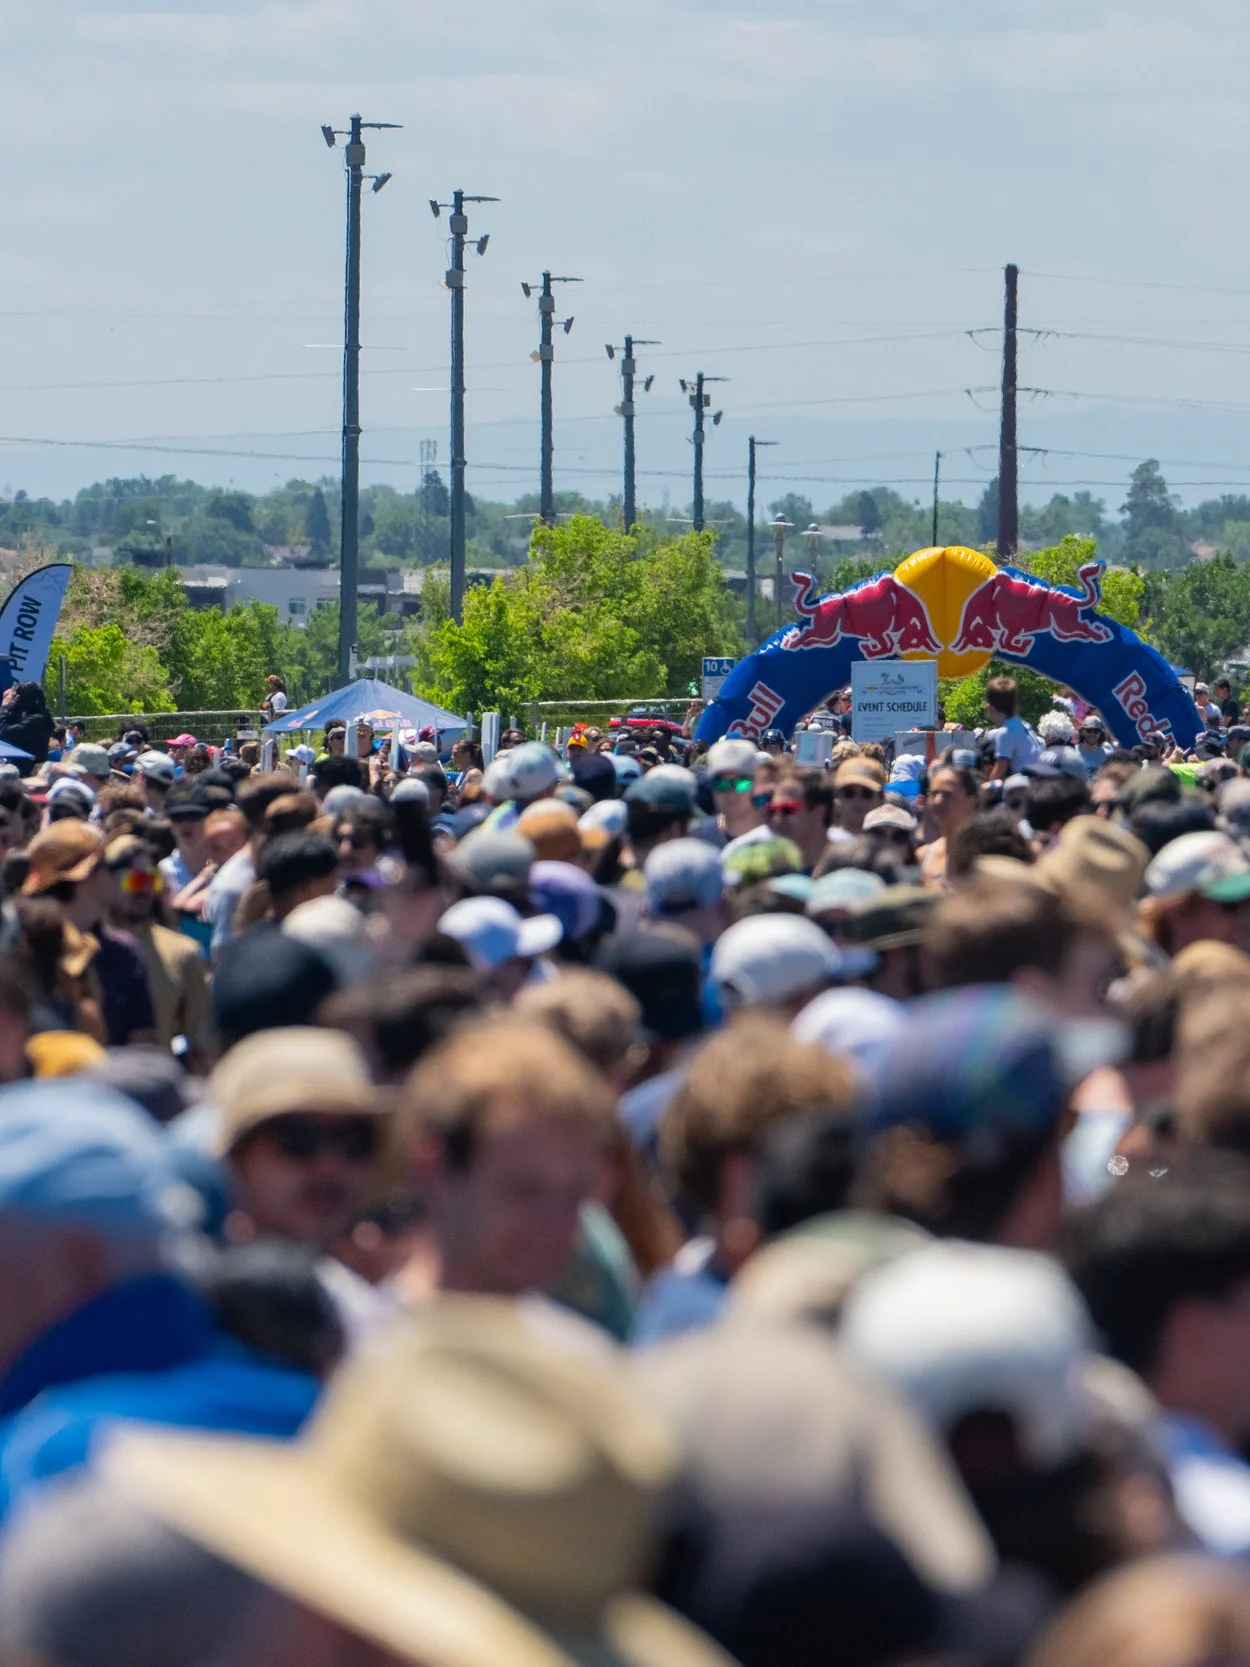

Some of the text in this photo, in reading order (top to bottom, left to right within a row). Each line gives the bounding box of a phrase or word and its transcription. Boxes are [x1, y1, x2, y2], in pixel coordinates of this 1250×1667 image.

[9, 595, 42, 672] PIT ROW
[705, 661, 718, 672] 10
[858, 701, 928, 713] EVENT SCHEDULE
